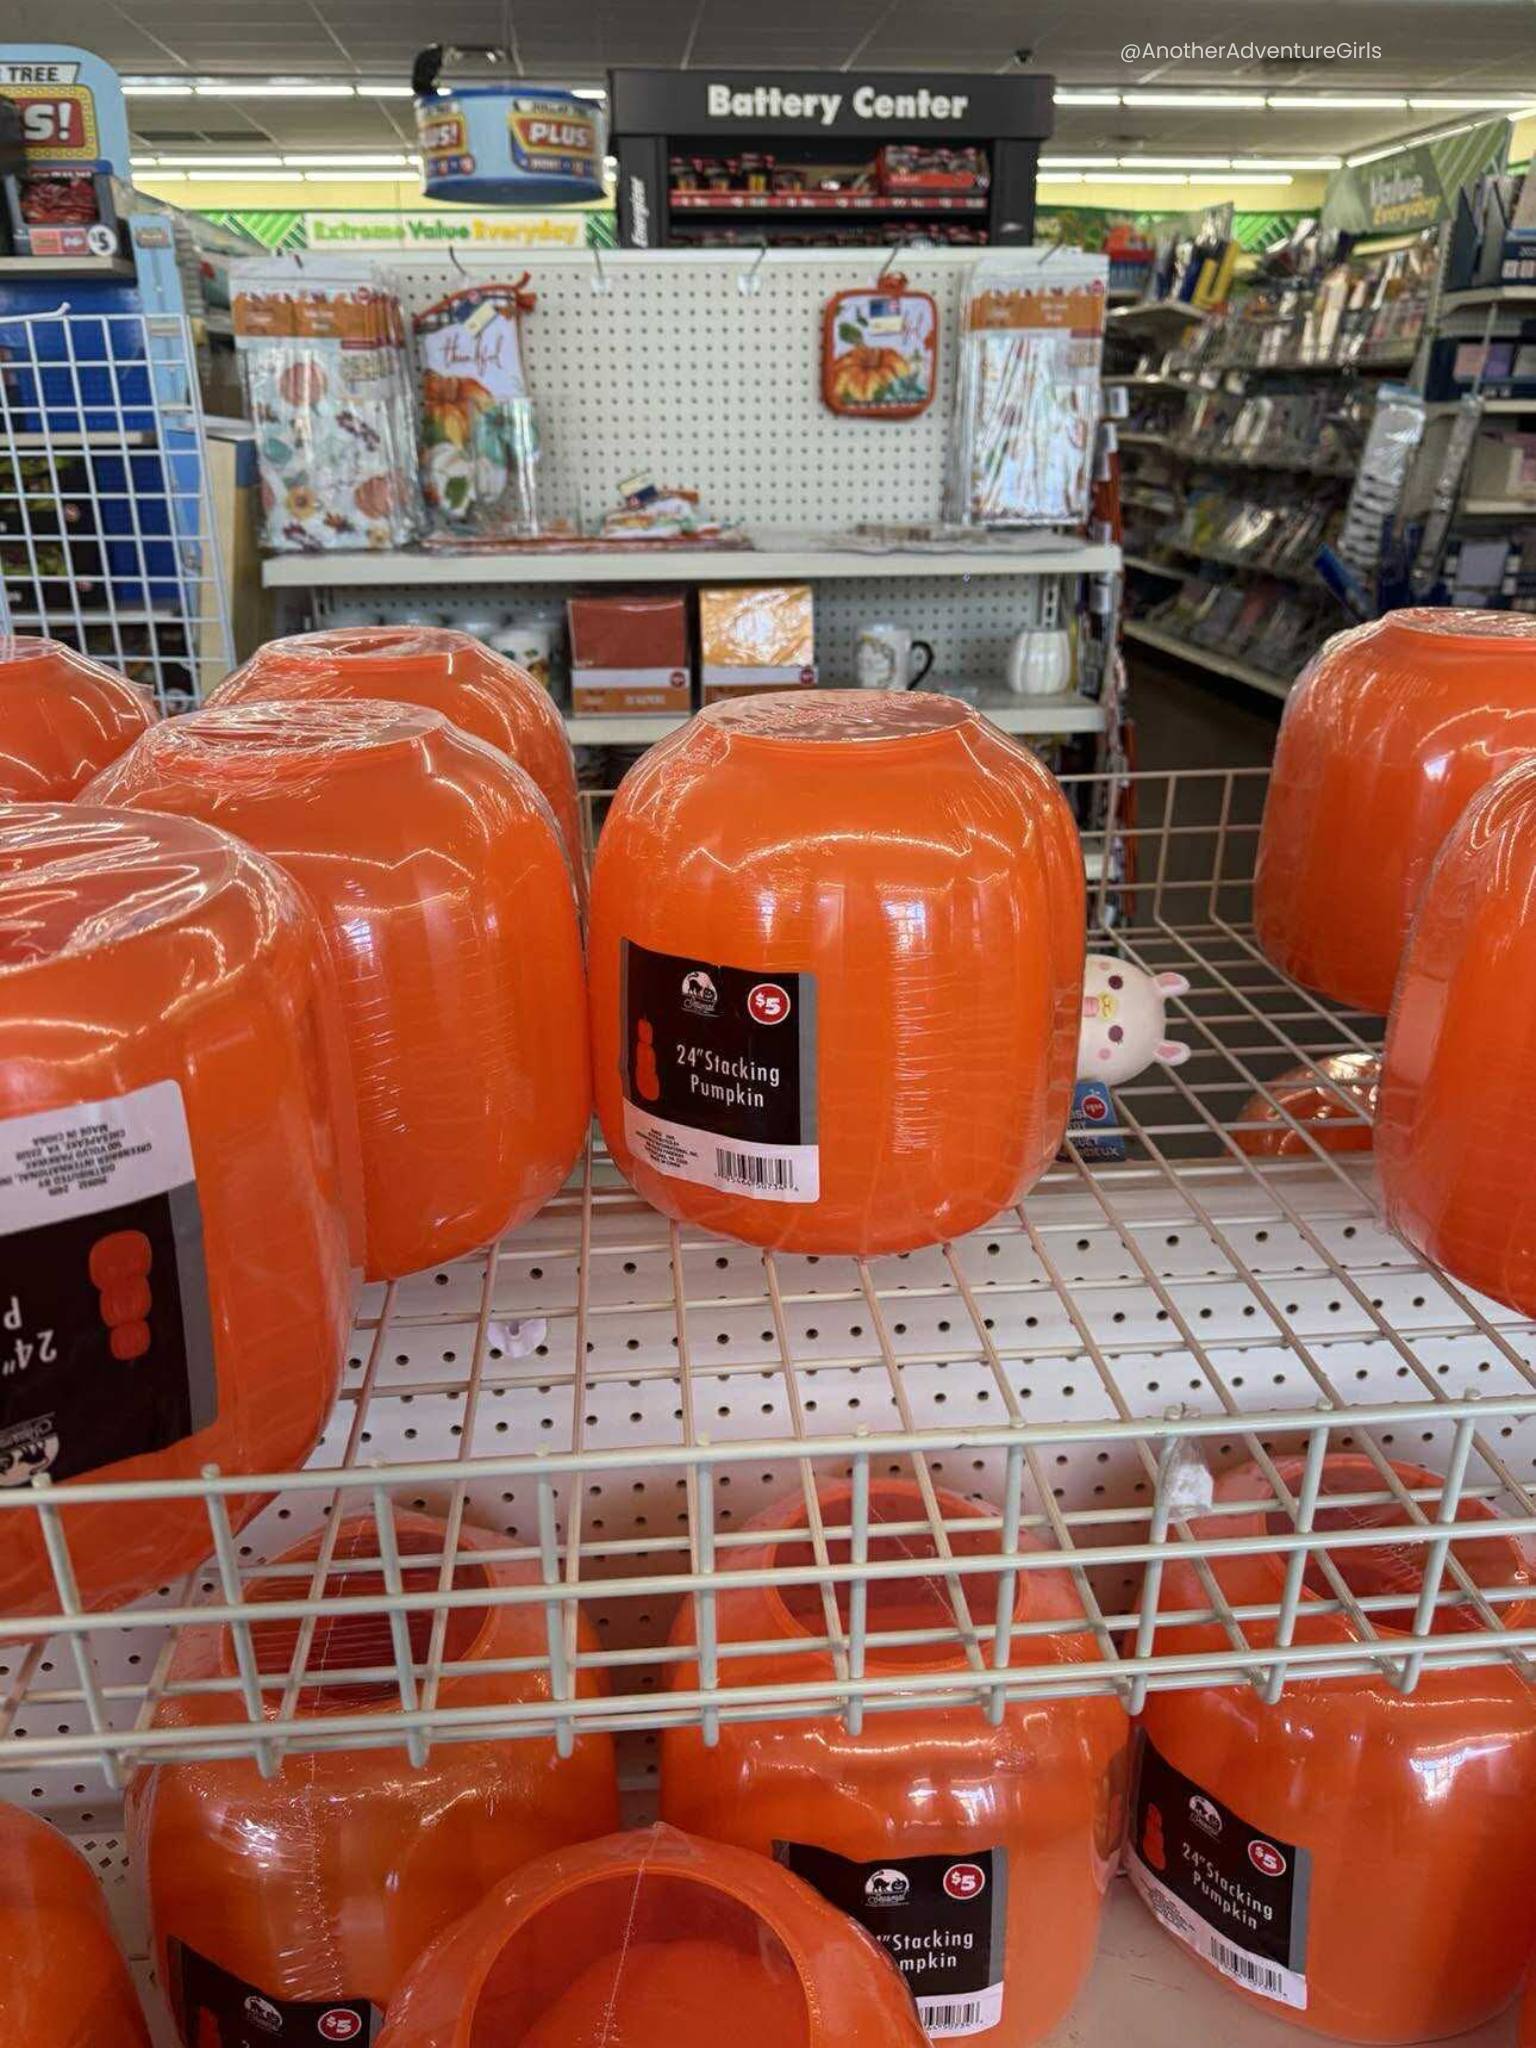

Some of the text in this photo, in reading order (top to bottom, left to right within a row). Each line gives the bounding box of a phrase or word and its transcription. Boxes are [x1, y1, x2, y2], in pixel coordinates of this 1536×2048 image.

[8, 66, 59, 82] TREE
[707, 84, 969, 126] Battery Center
[313, 219, 578, 246] Extreme Value Everyday
[755, 992, 781, 1016] $5
[691, 1074, 764, 1108] Pumpkin
[950, 1872, 976, 1891] $5
[1193, 1869, 1257, 1930] Pumpkin
[326, 2015, 352, 2034] $5
